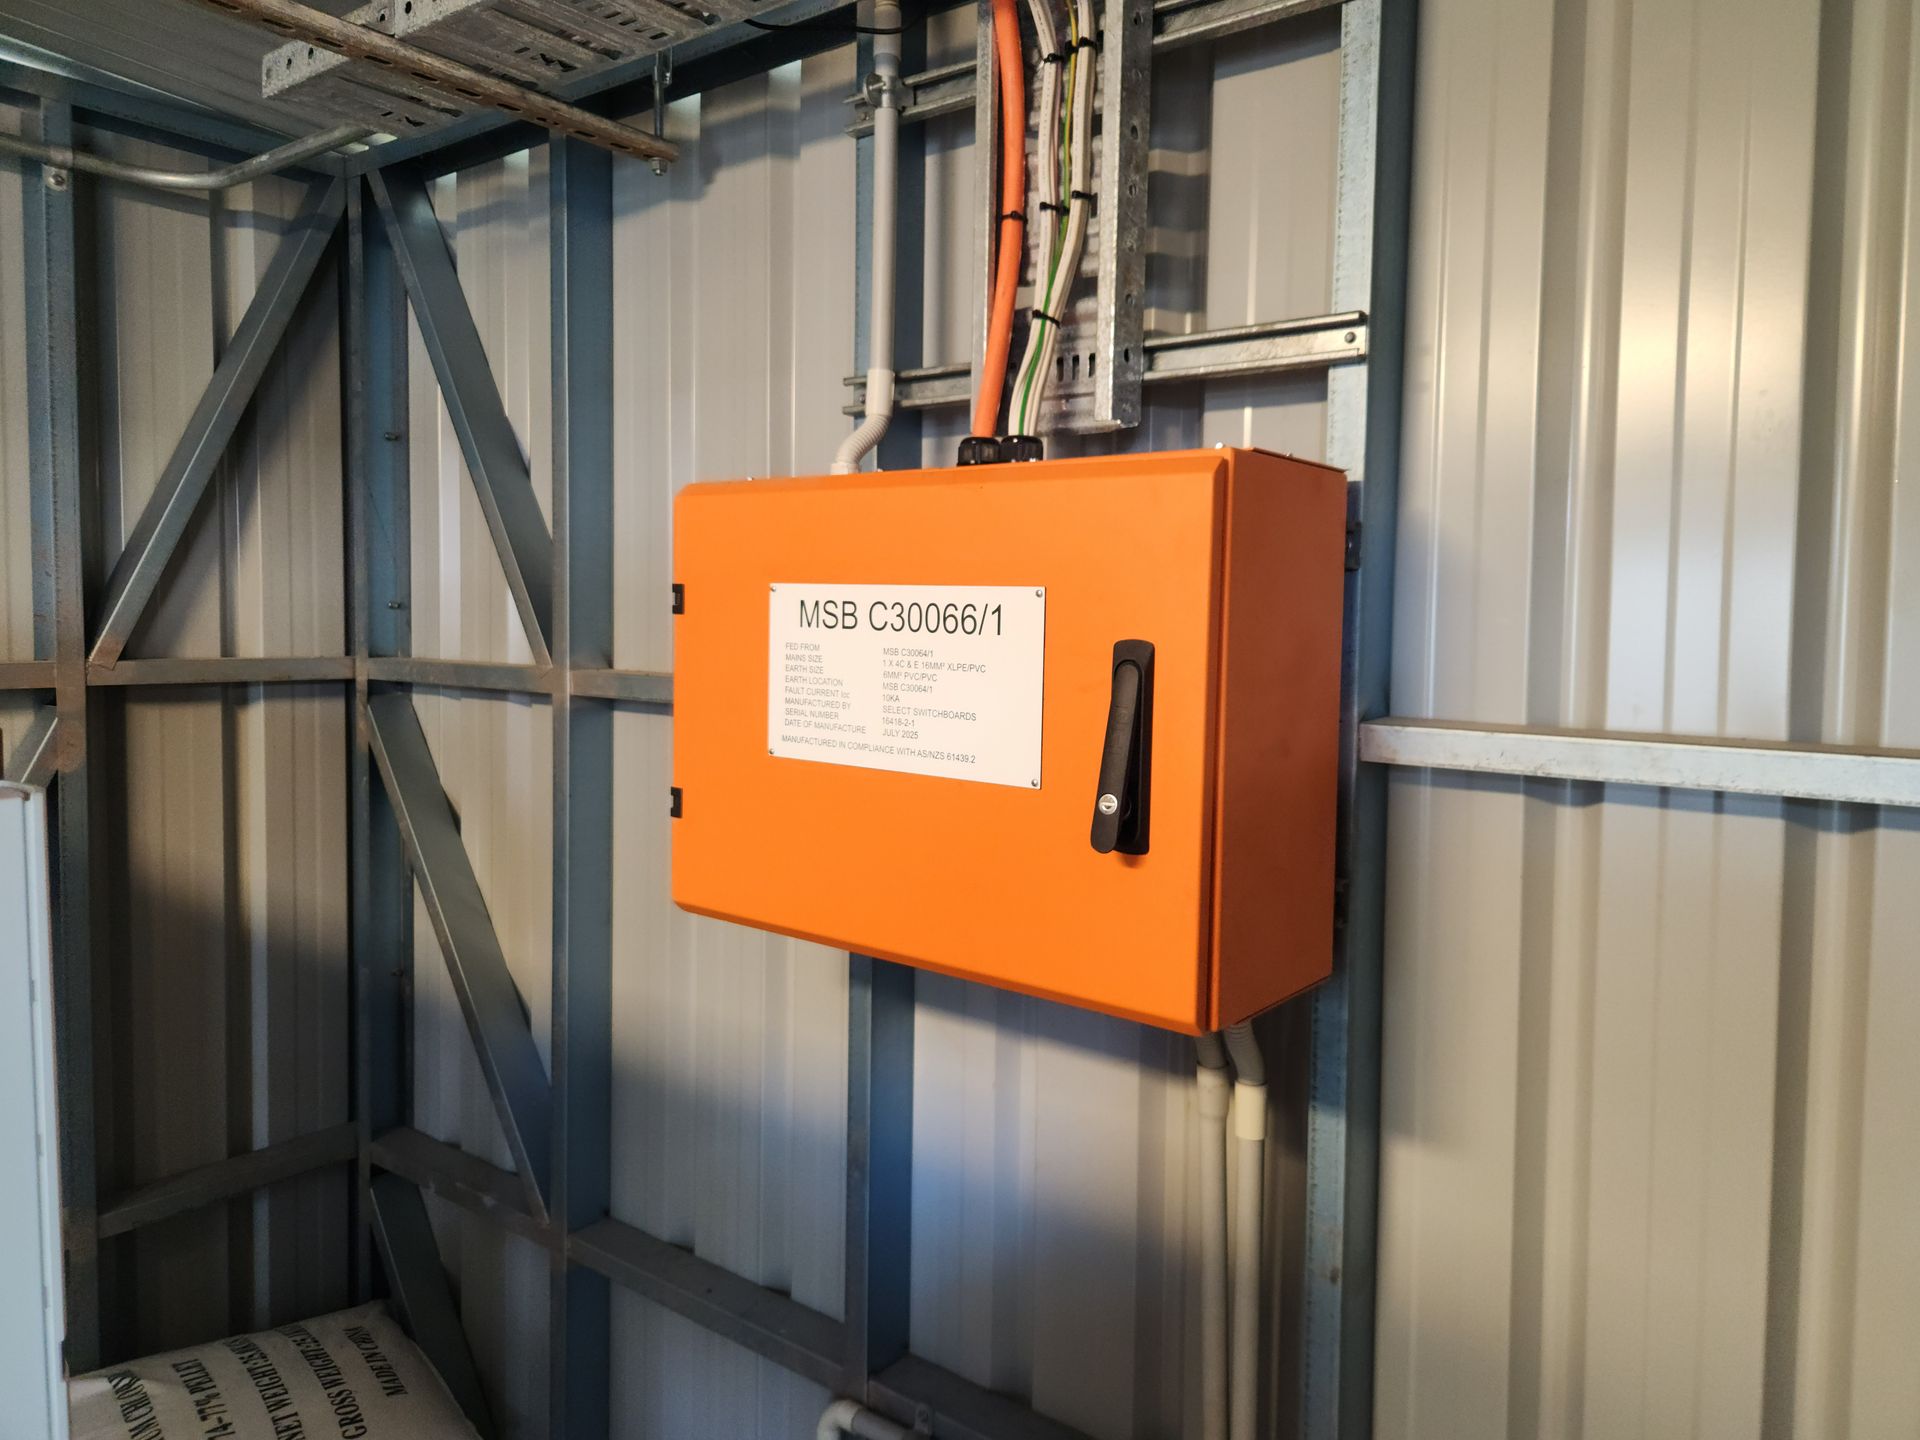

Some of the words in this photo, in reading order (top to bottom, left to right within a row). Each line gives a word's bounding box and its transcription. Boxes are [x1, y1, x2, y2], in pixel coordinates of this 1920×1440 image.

[800, 599, 858, 630] MSB
[869, 601, 1002, 636] C30066/1
[785, 642, 799, 651] FED
[800, 643, 820, 652] FROM
[883, 647, 899, 656] MSB
[901, 648, 934, 657] C30064/1
[785, 653, 807, 662] MAINS
[808, 655, 823, 663] SIZE
[785, 664, 807, 673] EARTH
[809, 666, 824, 674] SIZE
[883, 659, 887, 667] 1
[895, 660, 905, 668] 4C
[907, 661, 912, 669] &
[914, 661, 919, 669] E
[947, 663, 987, 673] XLPE/PVC
[785, 675, 807, 684] EARTH
[808, 677, 843, 687] LOCATION
[904, 672, 938, 682] PVC/PVC
[785, 686, 804, 695] FAULT
[806, 688, 839, 697] CURRENT
[882, 682, 899, 691] MSB
[784, 697, 840, 709] MANUFACTURED
[842, 701, 851, 709] BY
[883, 694, 900, 702] 10KA
[785, 708, 808, 717] SERIAL
[810, 710, 839, 719] NUMBER
[882, 705, 911, 715] SELECT
[913, 707, 977, 721] SWITCHBOARDS
[784, 719, 801, 727] DATE
[803, 720, 812, 728] OF
[814, 721, 867, 734] MANUFACTURE
[882, 729, 900, 737] JULY
[901, 730, 919, 739] 2025
[781, 734, 838, 748] MANUFACTURED
[847, 742, 894, 755] COMPLIANCE
[896, 747, 916, 756] WITH
[917, 749, 945, 760] AS/NZS
[946, 752, 976, 764] 61439.2
[361, 1351, 388, 1366] IN
[172, 1358, 217, 1395] PELLET
[369, 1363, 409, 1396] MADE
[326, 1388, 367, 1439] GROSS
